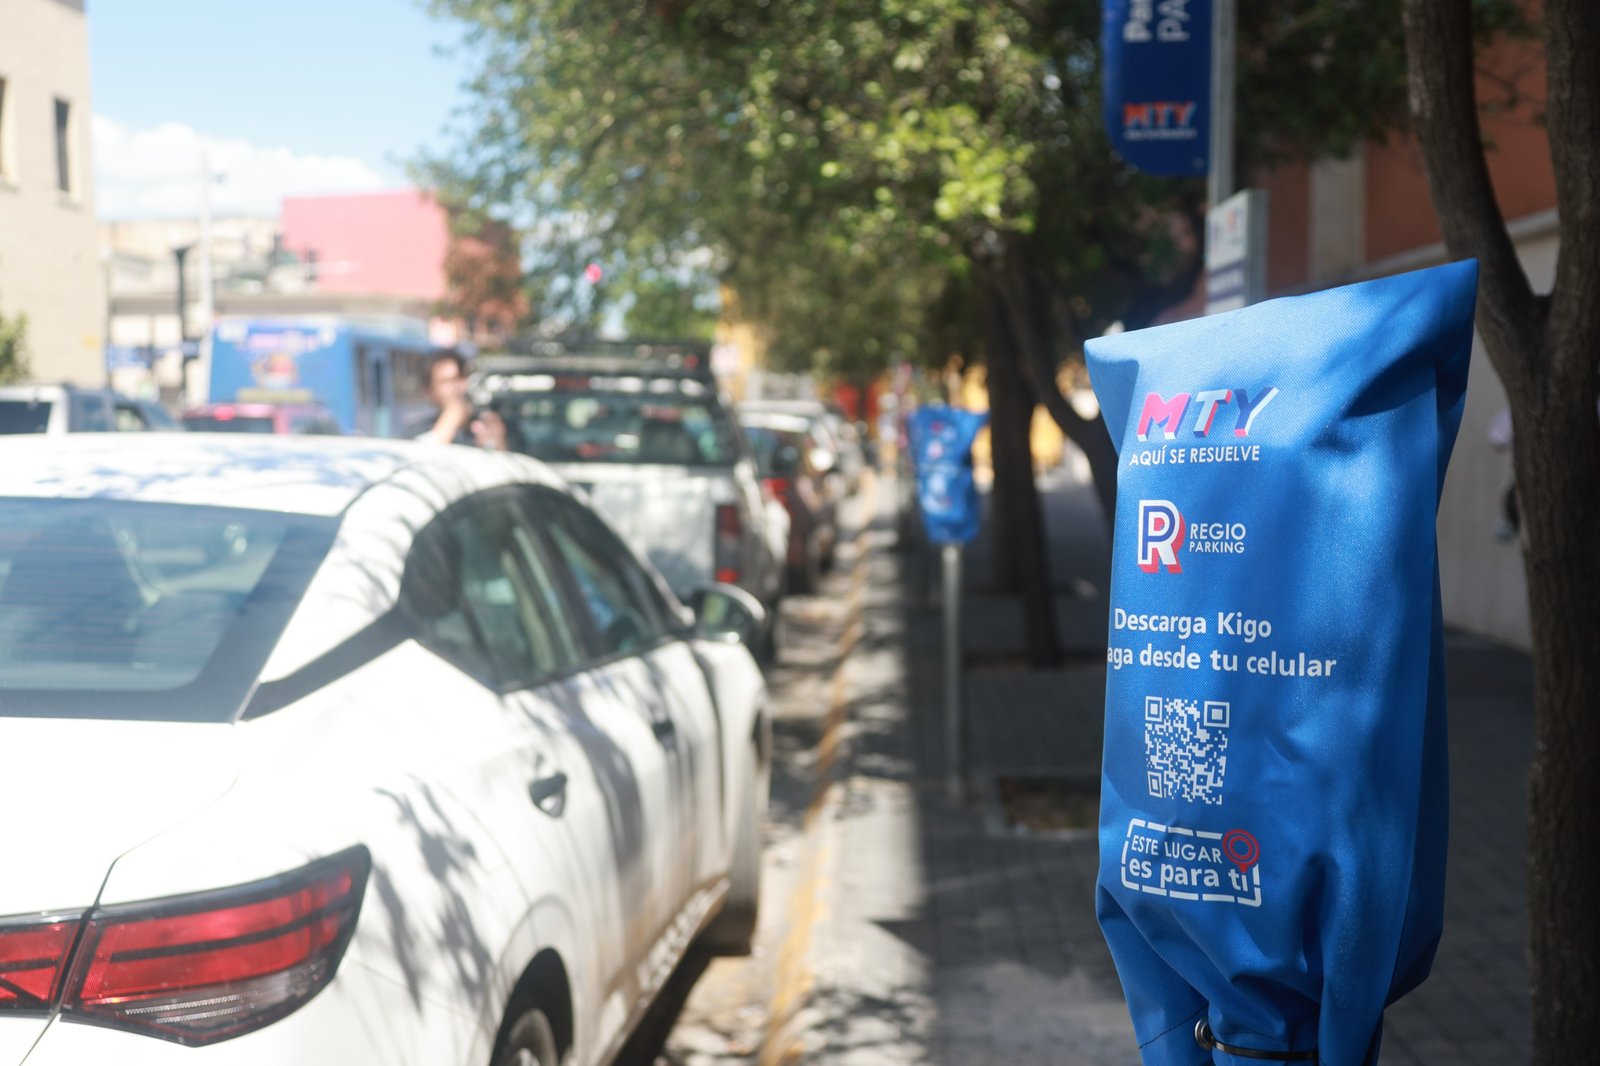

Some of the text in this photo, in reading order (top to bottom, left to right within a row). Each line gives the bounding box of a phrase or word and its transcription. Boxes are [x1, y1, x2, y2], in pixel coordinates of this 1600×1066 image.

[1123, 102, 1198, 129] MTY
[1136, 387, 1279, 442] MTY
[1129, 445, 1261, 466] AQUÍ SE RESUELVE
[1189, 523, 1247, 540] REGIO
[1189, 541, 1245, 554] PARKING
[1114, 608, 1272, 643] Descarga Kigo
[1107, 643, 1337, 677] aga desde tu celular
[1131, 834, 1223, 864] ESTE LUGAR
[1129, 857, 1248, 891] es para ti
